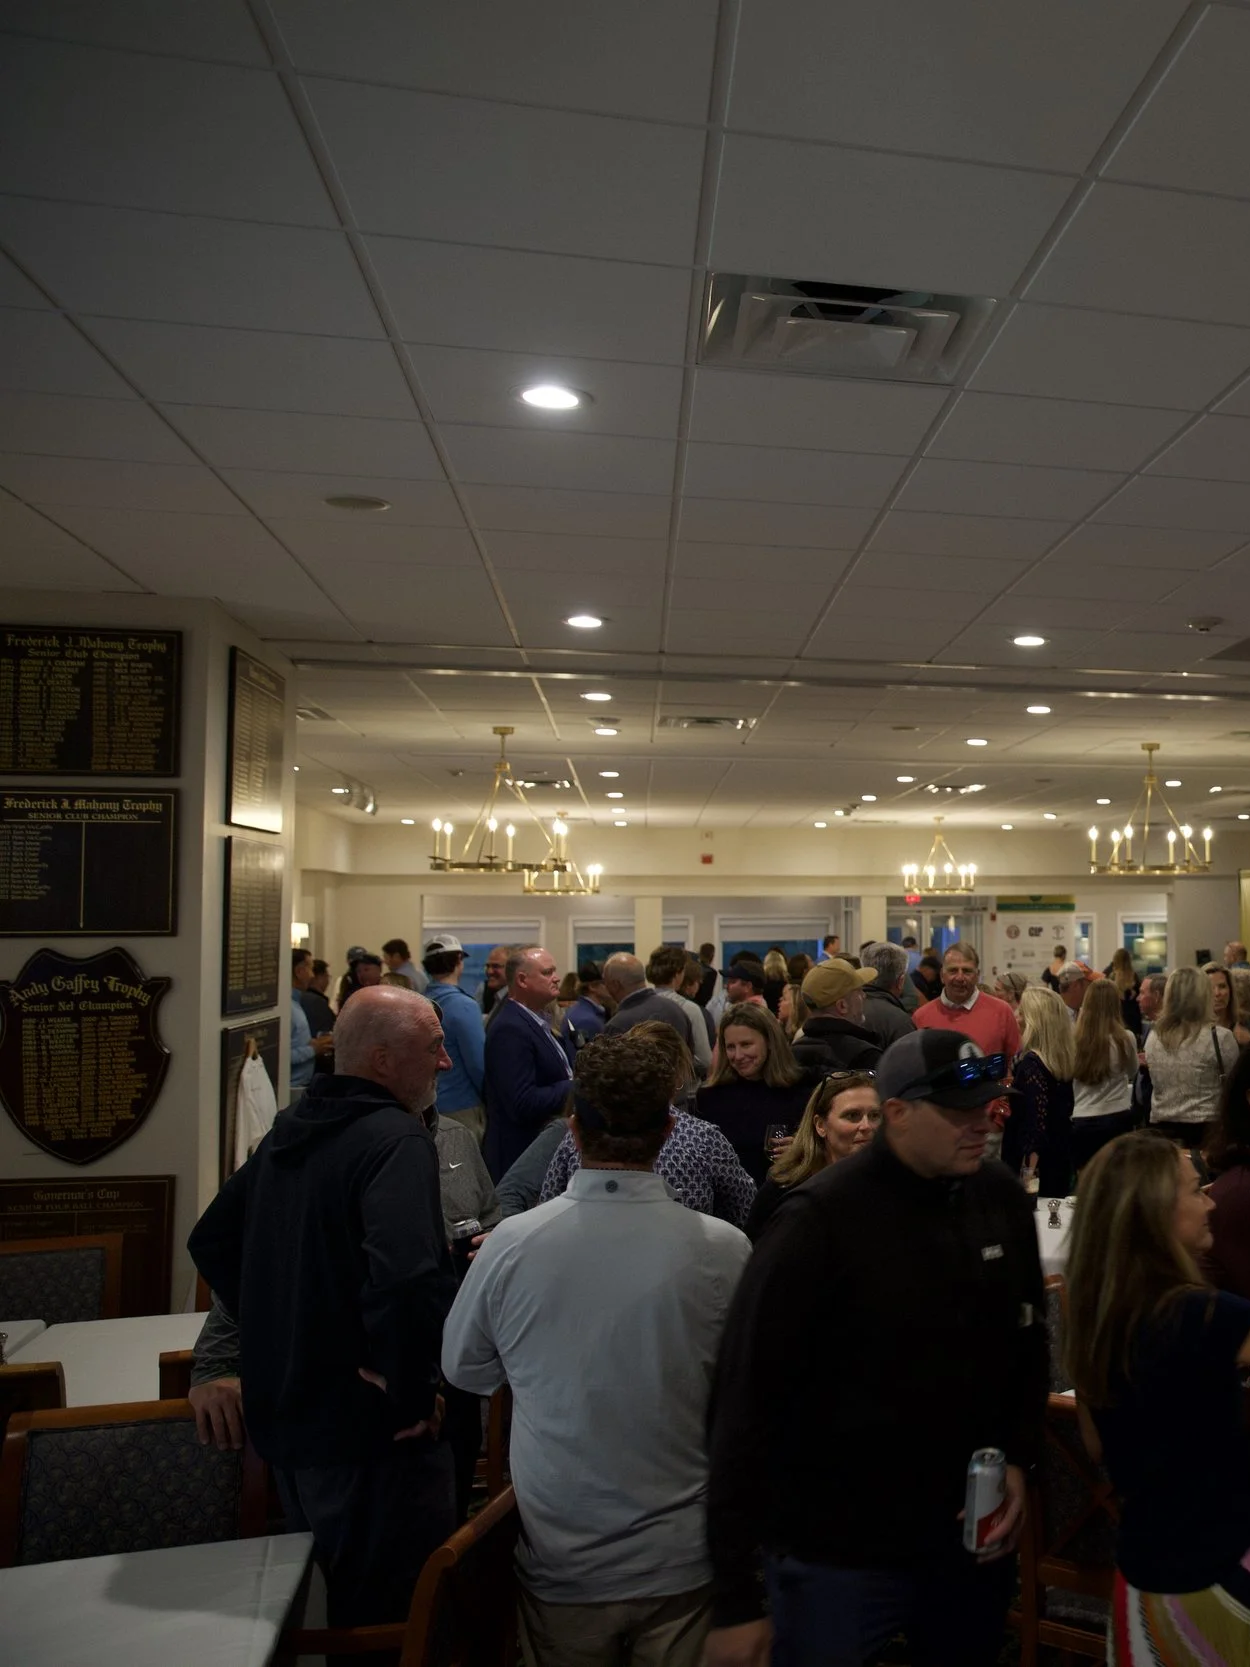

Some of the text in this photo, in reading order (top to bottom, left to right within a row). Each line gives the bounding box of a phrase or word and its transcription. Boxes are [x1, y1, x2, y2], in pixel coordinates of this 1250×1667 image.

[5, 634, 60, 648] Frederick
[128, 638, 167, 653] Trophy
[3, 797, 58, 810] Frederick
[74, 798, 120, 812] Mahony
[122, 800, 163, 814] Trophy
[9, 973, 152, 1008] Andy Gaffey Trophy
[21, 1000, 133, 1013] Senior Net Champion
[33, 1188, 120, 1202] Governor's Cup
